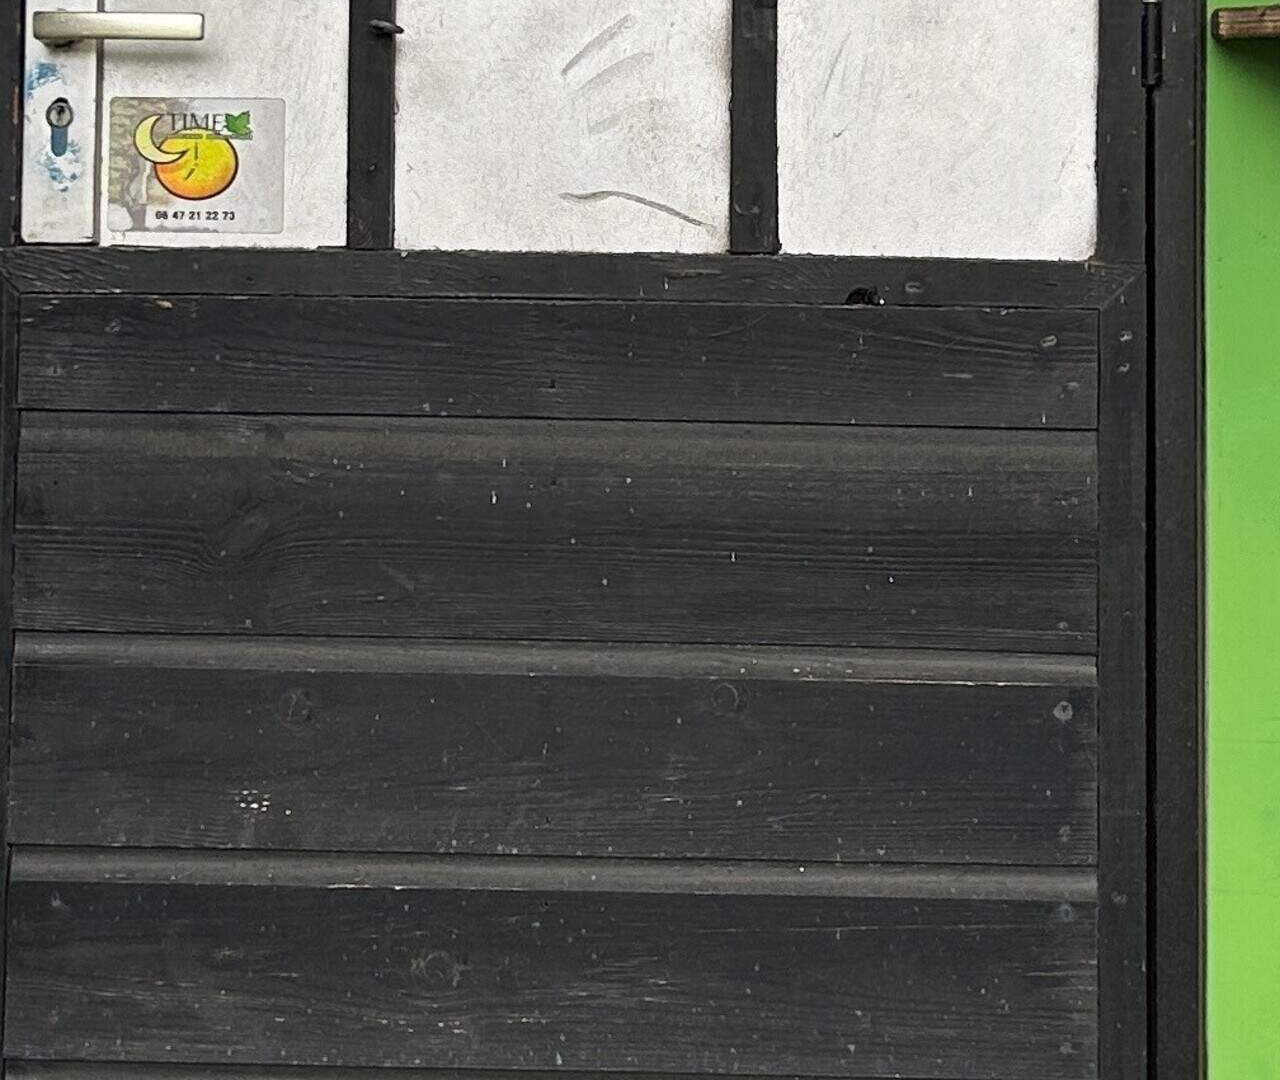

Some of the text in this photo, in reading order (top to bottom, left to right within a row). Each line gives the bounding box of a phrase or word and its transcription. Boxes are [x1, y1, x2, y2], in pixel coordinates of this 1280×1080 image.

[172, 210, 185, 221] 47
[188, 210, 201, 221] 21
[205, 210, 219, 221] 22
[222, 210, 236, 221] 73
